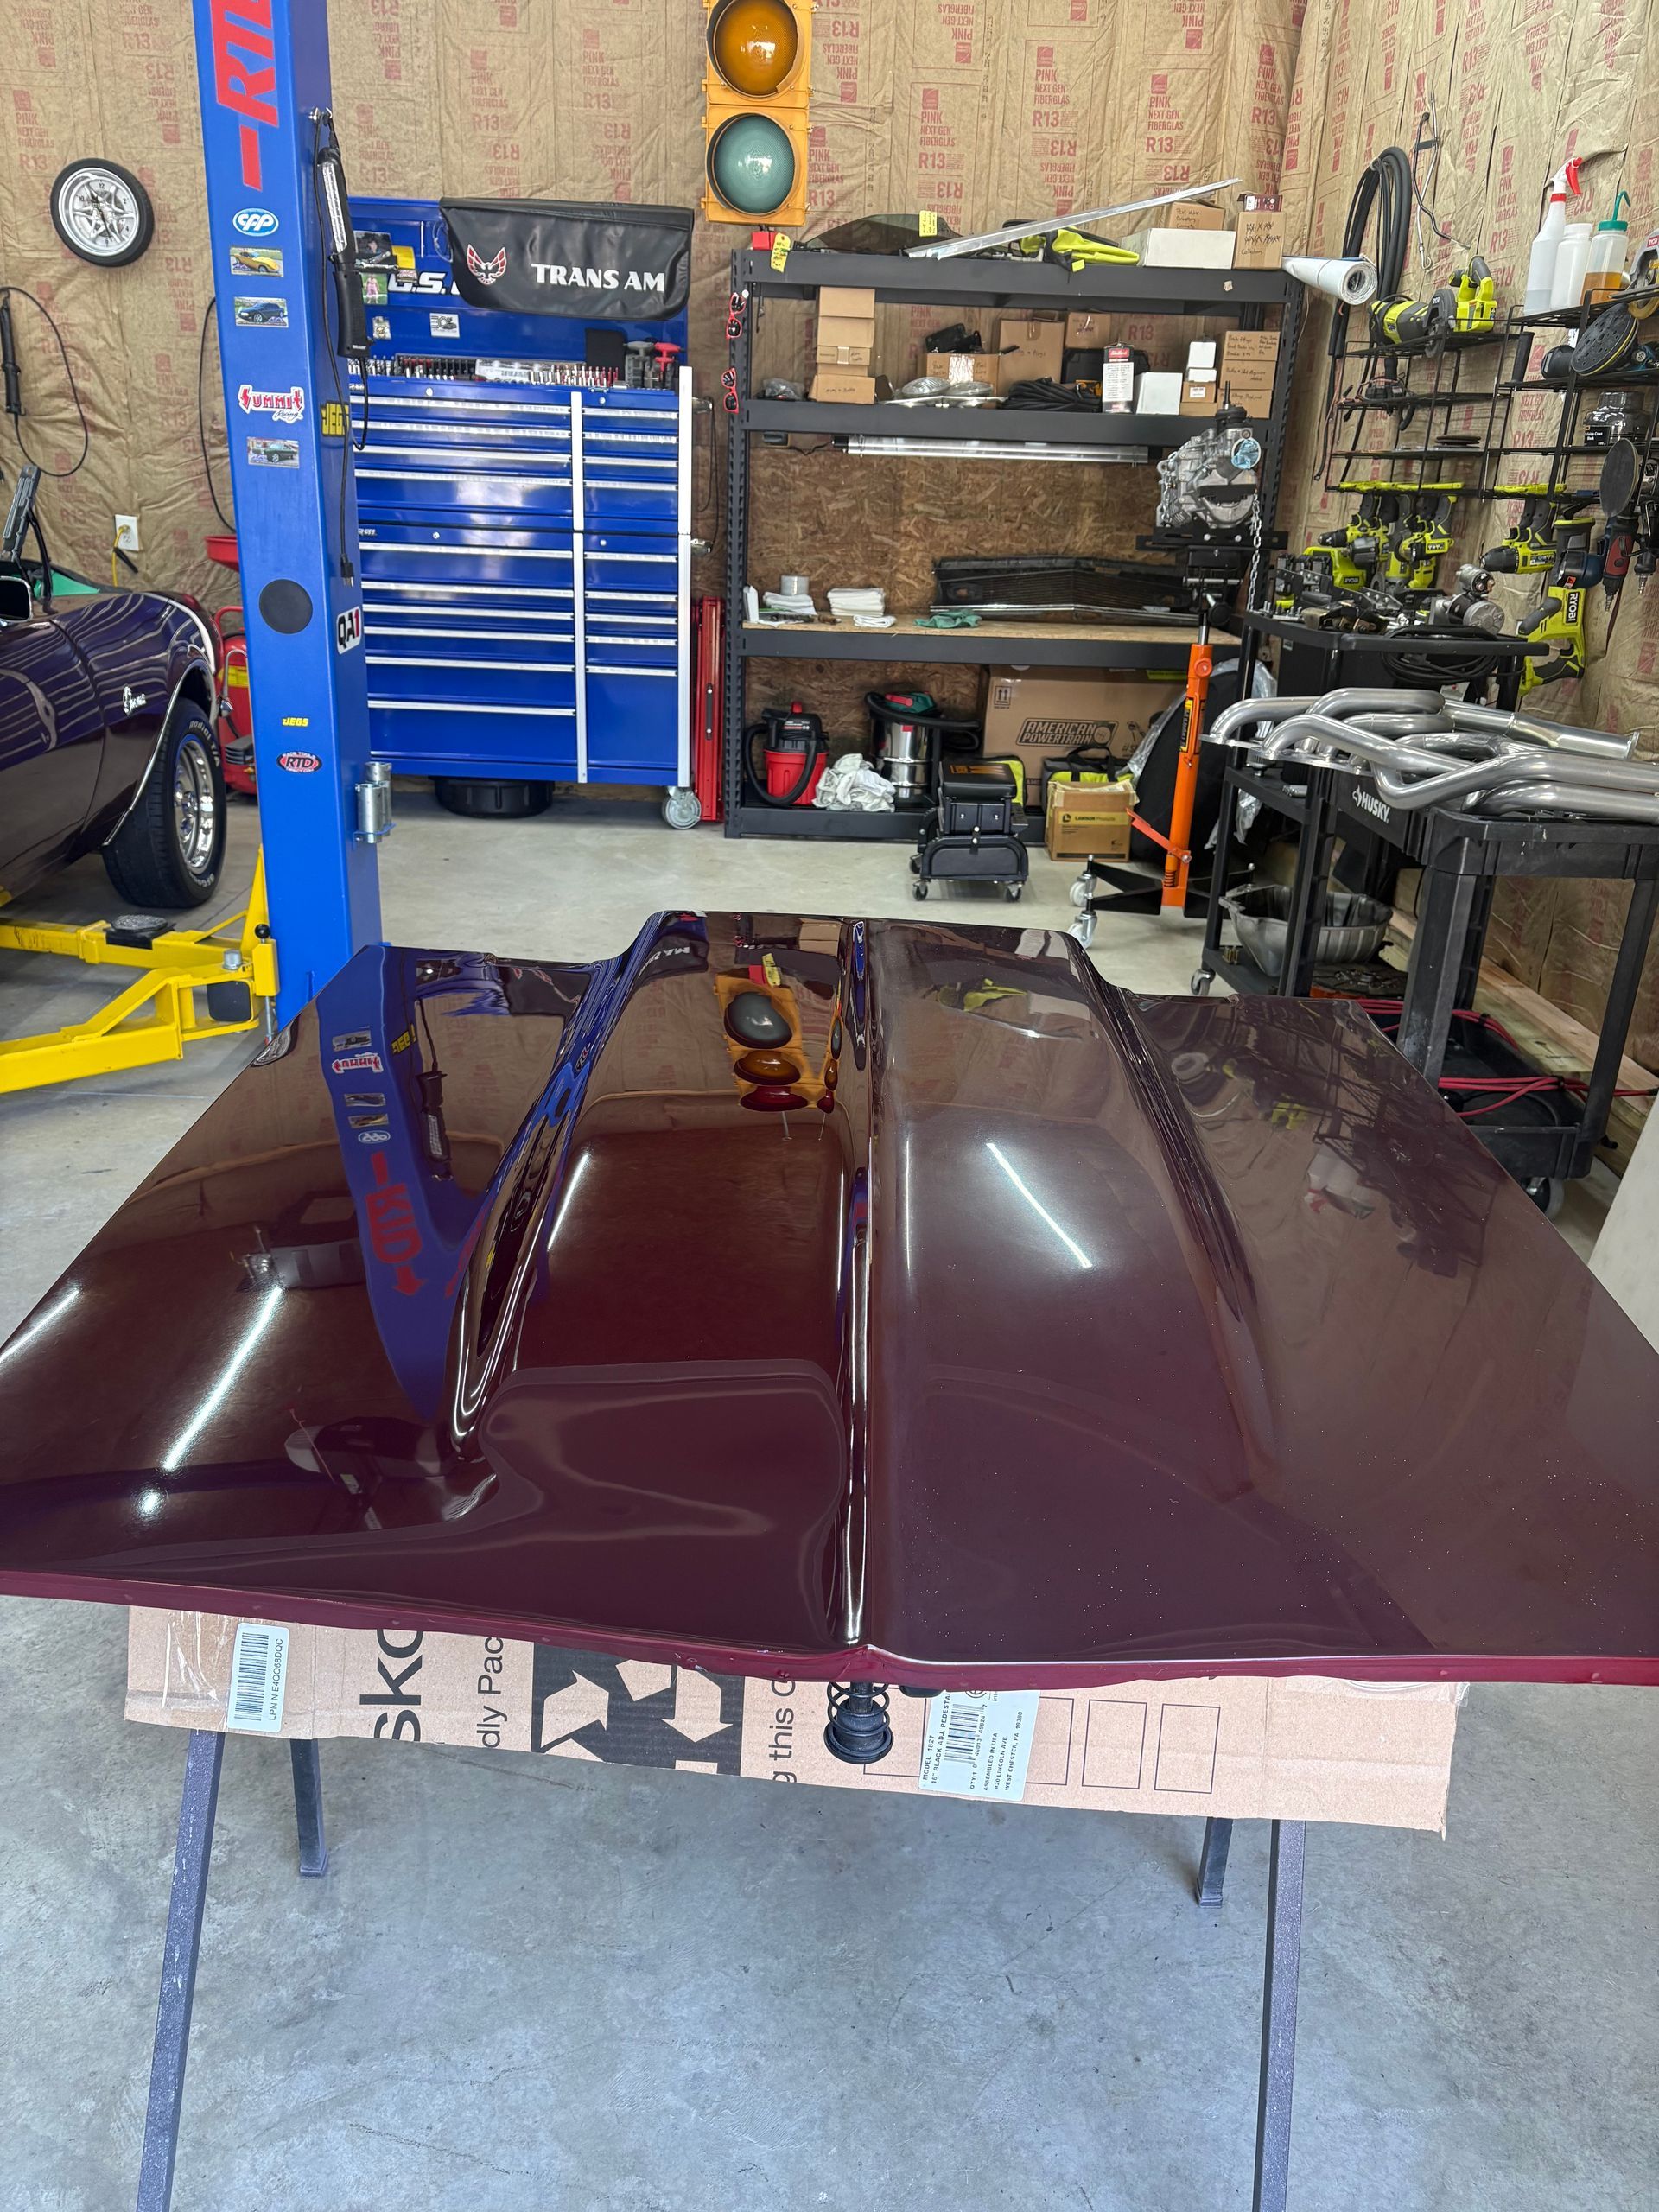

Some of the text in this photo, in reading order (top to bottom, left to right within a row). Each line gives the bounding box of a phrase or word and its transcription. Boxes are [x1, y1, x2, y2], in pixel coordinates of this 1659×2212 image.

[938, 4, 975, 14] FIBERGLAS
[1173, 3, 1205, 13] NEXT GEN
[942, 16, 974, 26] NEXT GEN
[1182, 16, 1204, 28] PINK
[831, 21, 860, 38] R13
[951, 28, 973, 40] PINK
[823, 43, 859, 54] FIBERGLAS
[583, 51, 605, 63] PINK
[827, 55, 858, 66] NEXT GEN
[1463, 46, 1478, 73] R13
[836, 67, 858, 79] PINK
[1036, 69, 1058, 81] PINK
[1257, 67, 1276, 79] PINK
[1035, 84, 1065, 93] NEXT GEN
[1256, 80, 1281, 94] NEXT GEN
[583, 92, 611, 110] R13
[1034, 95, 1070, 105] FIBERGLAS
[1148, 97, 1171, 108] PINK
[472, 113, 499, 130] R13
[921, 111, 942, 124] PINK
[1033, 111, 1059, 127] R13
[1148, 111, 1179, 119] NEXT GEN
[1252, 106, 1276, 125] R13
[605, 123, 631, 140] R13
[920, 125, 951, 135] NEXT GEN
[1147, 121, 1184, 130] FIBERGLAS
[919, 137, 955, 147] FIBERGLAS
[1050, 140, 1077, 156] R13
[1146, 137, 1173, 153] R13
[493, 143, 520, 161] R13
[809, 149, 830, 162] PINK
[19, 153, 48, 170] R13
[918, 152, 945, 169] R13
[1040, 162, 1075, 172] FIBERGLAS
[1058, 175, 1075, 184] NEXT
[1163, 165, 1190, 181] R13
[937, 182, 963, 199] R13
[1053, 185, 1074, 198] PINK
[809, 189, 835, 207] R13
[1490, 228, 1509, 254] R13
[531, 263, 665, 292] TRANS AM
[1496, 265, 1515, 288] R13
[1128, 325, 1154, 340] R13
[1567, 593, 1579, 621] RYOBI
[338, 608, 360, 649] QA1
[283, 717, 308, 727] JEGS
[1026, 721, 1096, 735] AMERICAN
[1021, 732, 1093, 746] POWERTRAIN
[286, 757, 315, 767] RTD
[269, 1702, 277, 1721] LPN
[476, 1705, 507, 1748] dly
[933, 1748, 942, 1771] BLACK
[940, 1691, 950, 1728] PEDESTAL
[768, 1707, 794, 1761] this
[1014, 1732, 1020, 1741] PA
[923, 1757, 931, 1780] MODEL
[996, 1751, 1006, 1778] LINCOLN
[983, 1755, 994, 1790] ASSEMBLED
